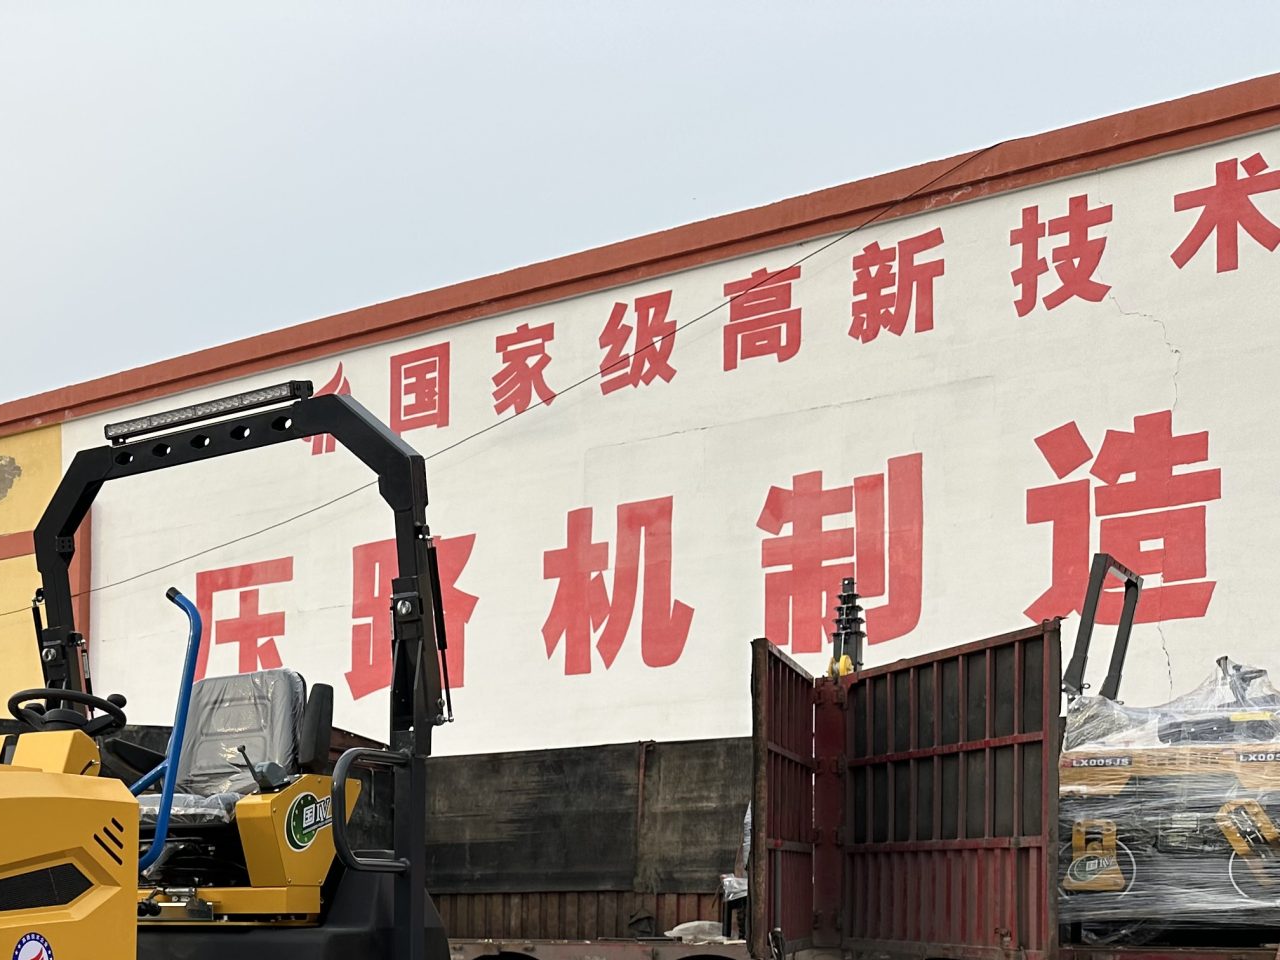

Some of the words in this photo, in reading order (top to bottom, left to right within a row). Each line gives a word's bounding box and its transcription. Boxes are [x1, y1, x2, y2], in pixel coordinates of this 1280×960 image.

[390, 152, 1280, 435] 国家级高新技术
[194, 409, 1222, 701] 压路机制造
